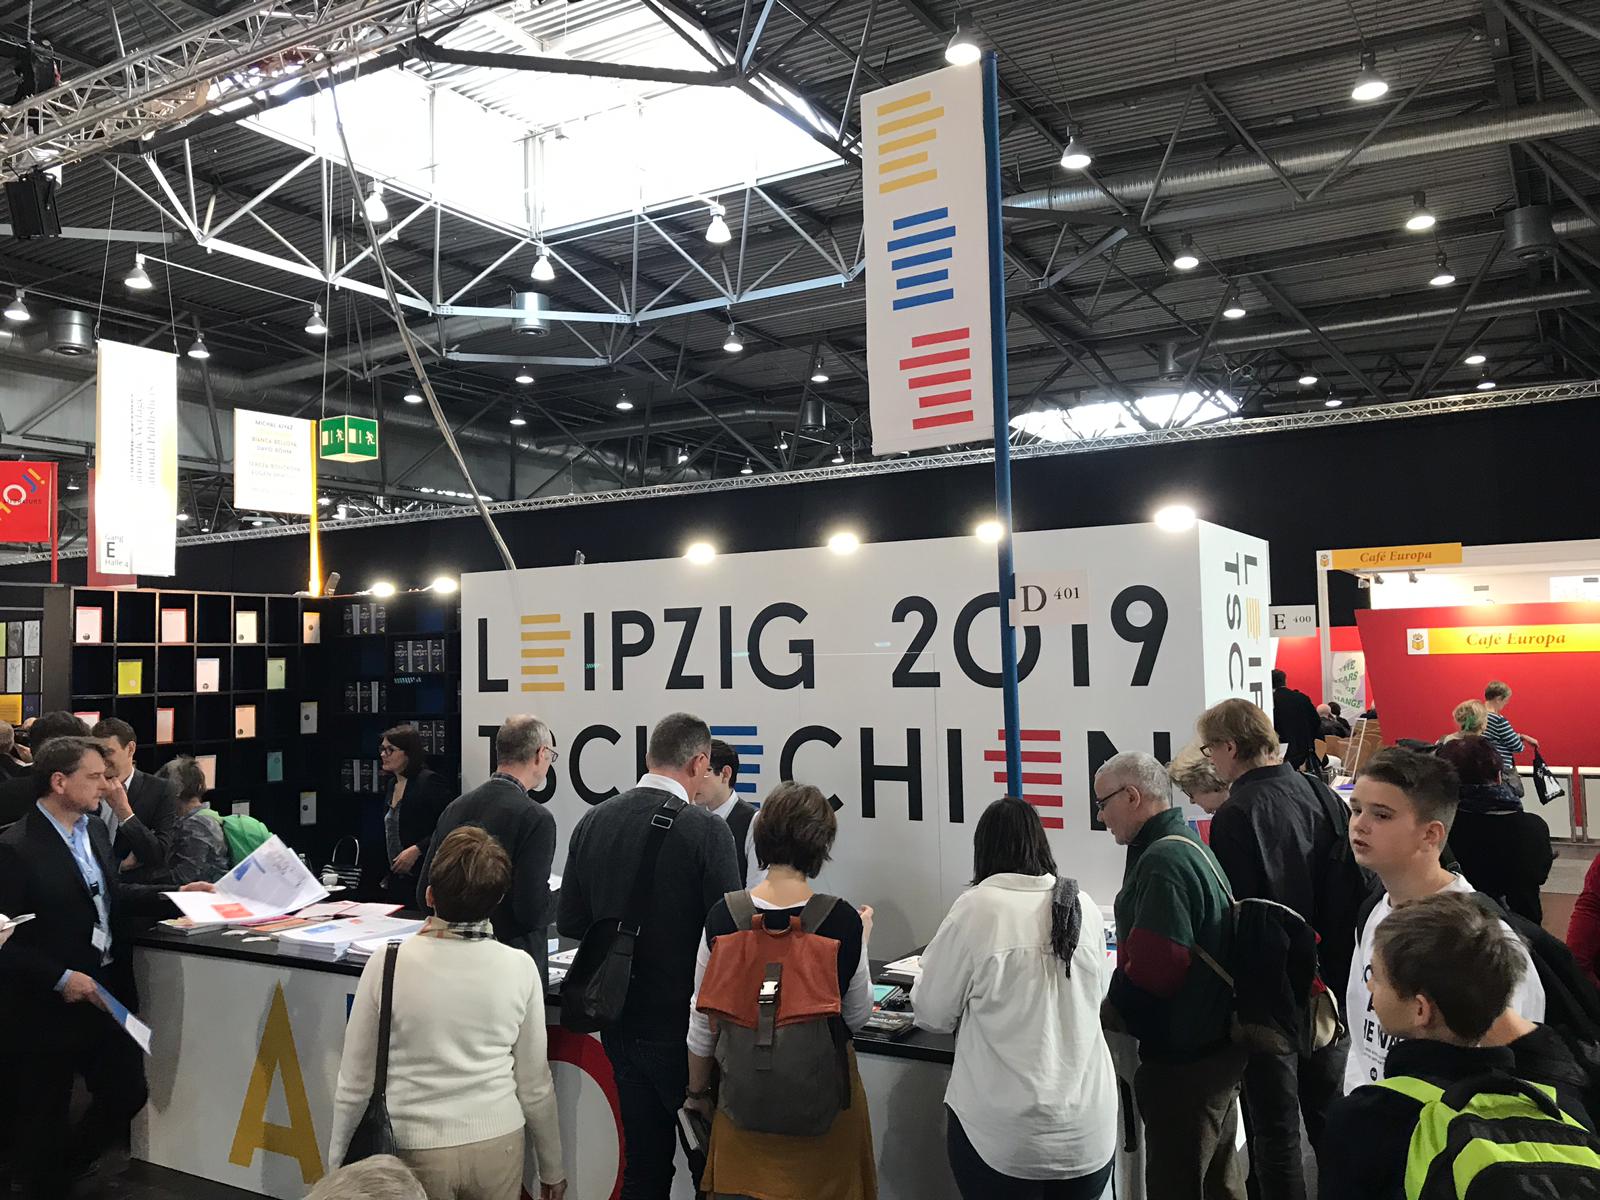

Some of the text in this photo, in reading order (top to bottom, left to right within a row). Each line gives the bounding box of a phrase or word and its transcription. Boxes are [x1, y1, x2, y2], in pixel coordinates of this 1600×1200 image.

[106, 541, 115, 558] E
[1360, 550, 1432, 565] Café Europa
[1020, 584, 1081, 612] D 401
[1272, 613, 1287, 630] E
[478, 584, 1169, 693] LEIPZIG 2019
[1507, 632, 1566, 648] Europa
